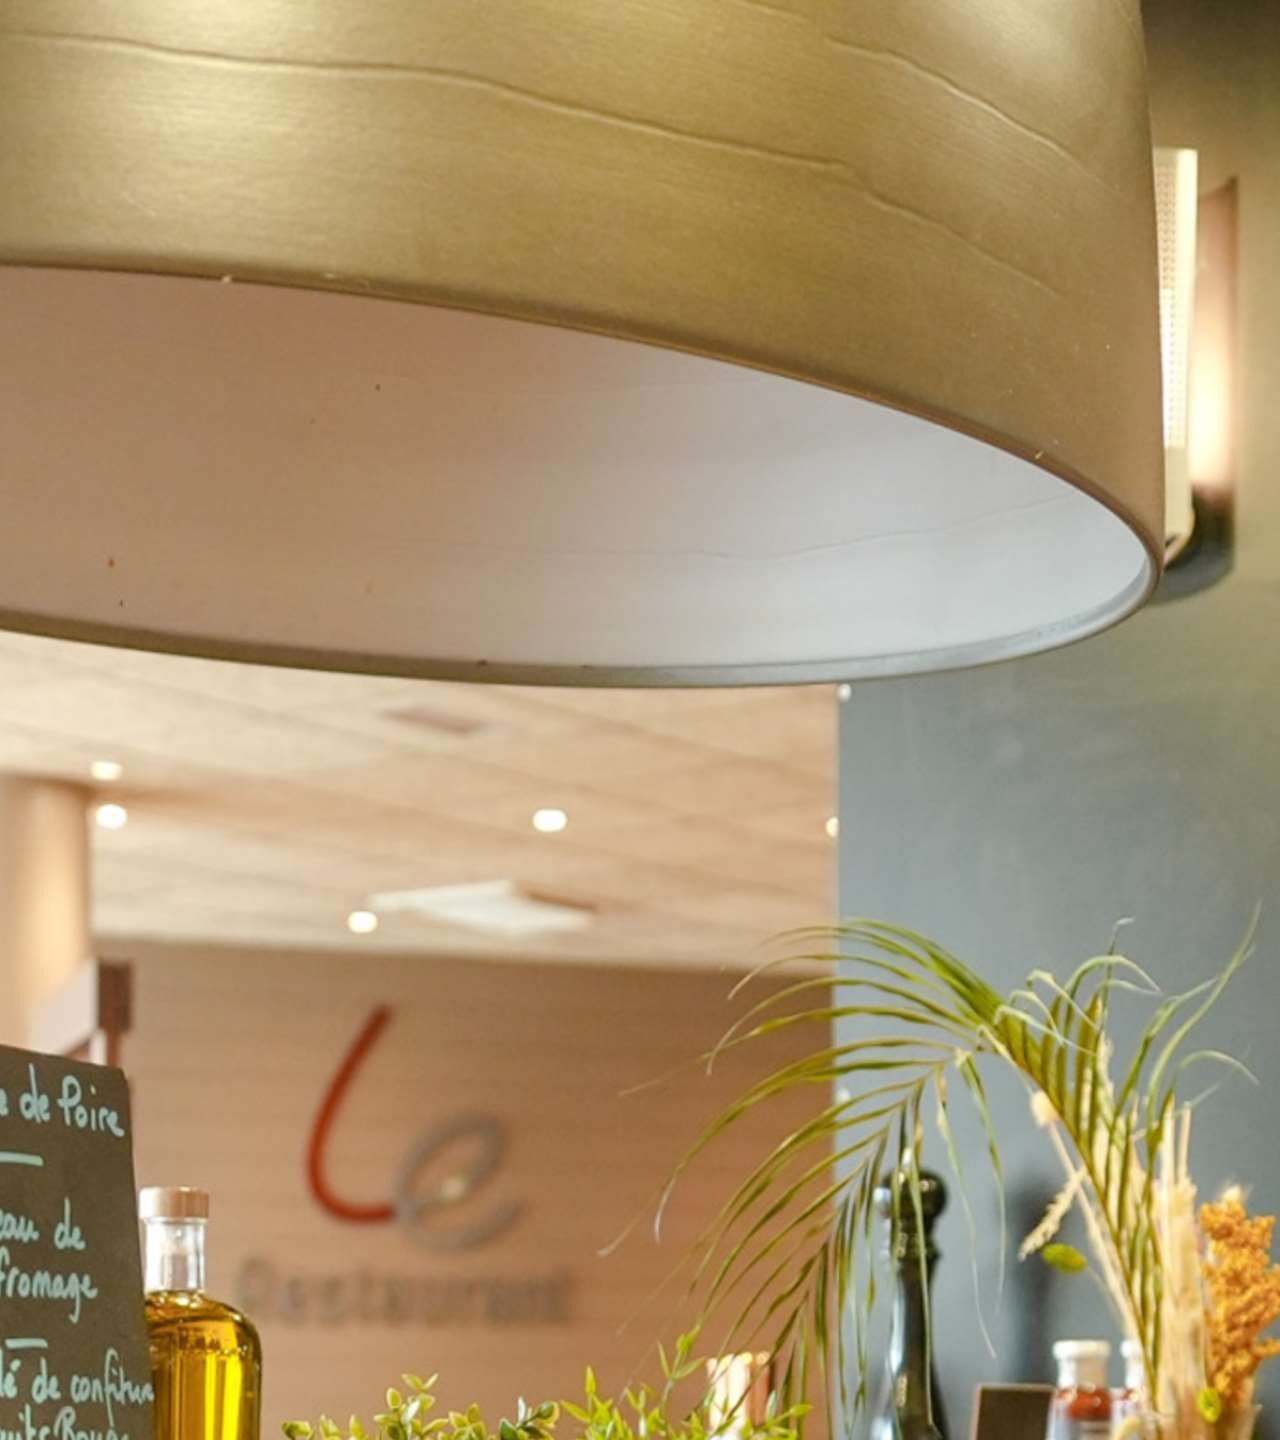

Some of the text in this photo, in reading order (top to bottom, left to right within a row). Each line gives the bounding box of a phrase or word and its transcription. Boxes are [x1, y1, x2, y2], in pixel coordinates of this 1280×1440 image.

[20, 1062, 51, 1124] de
[57, 1074, 125, 1137] Poire
[305, 1002, 525, 1256] Le
[54, 1196, 86, 1251] de
[31, 1356, 62, 1404] de
